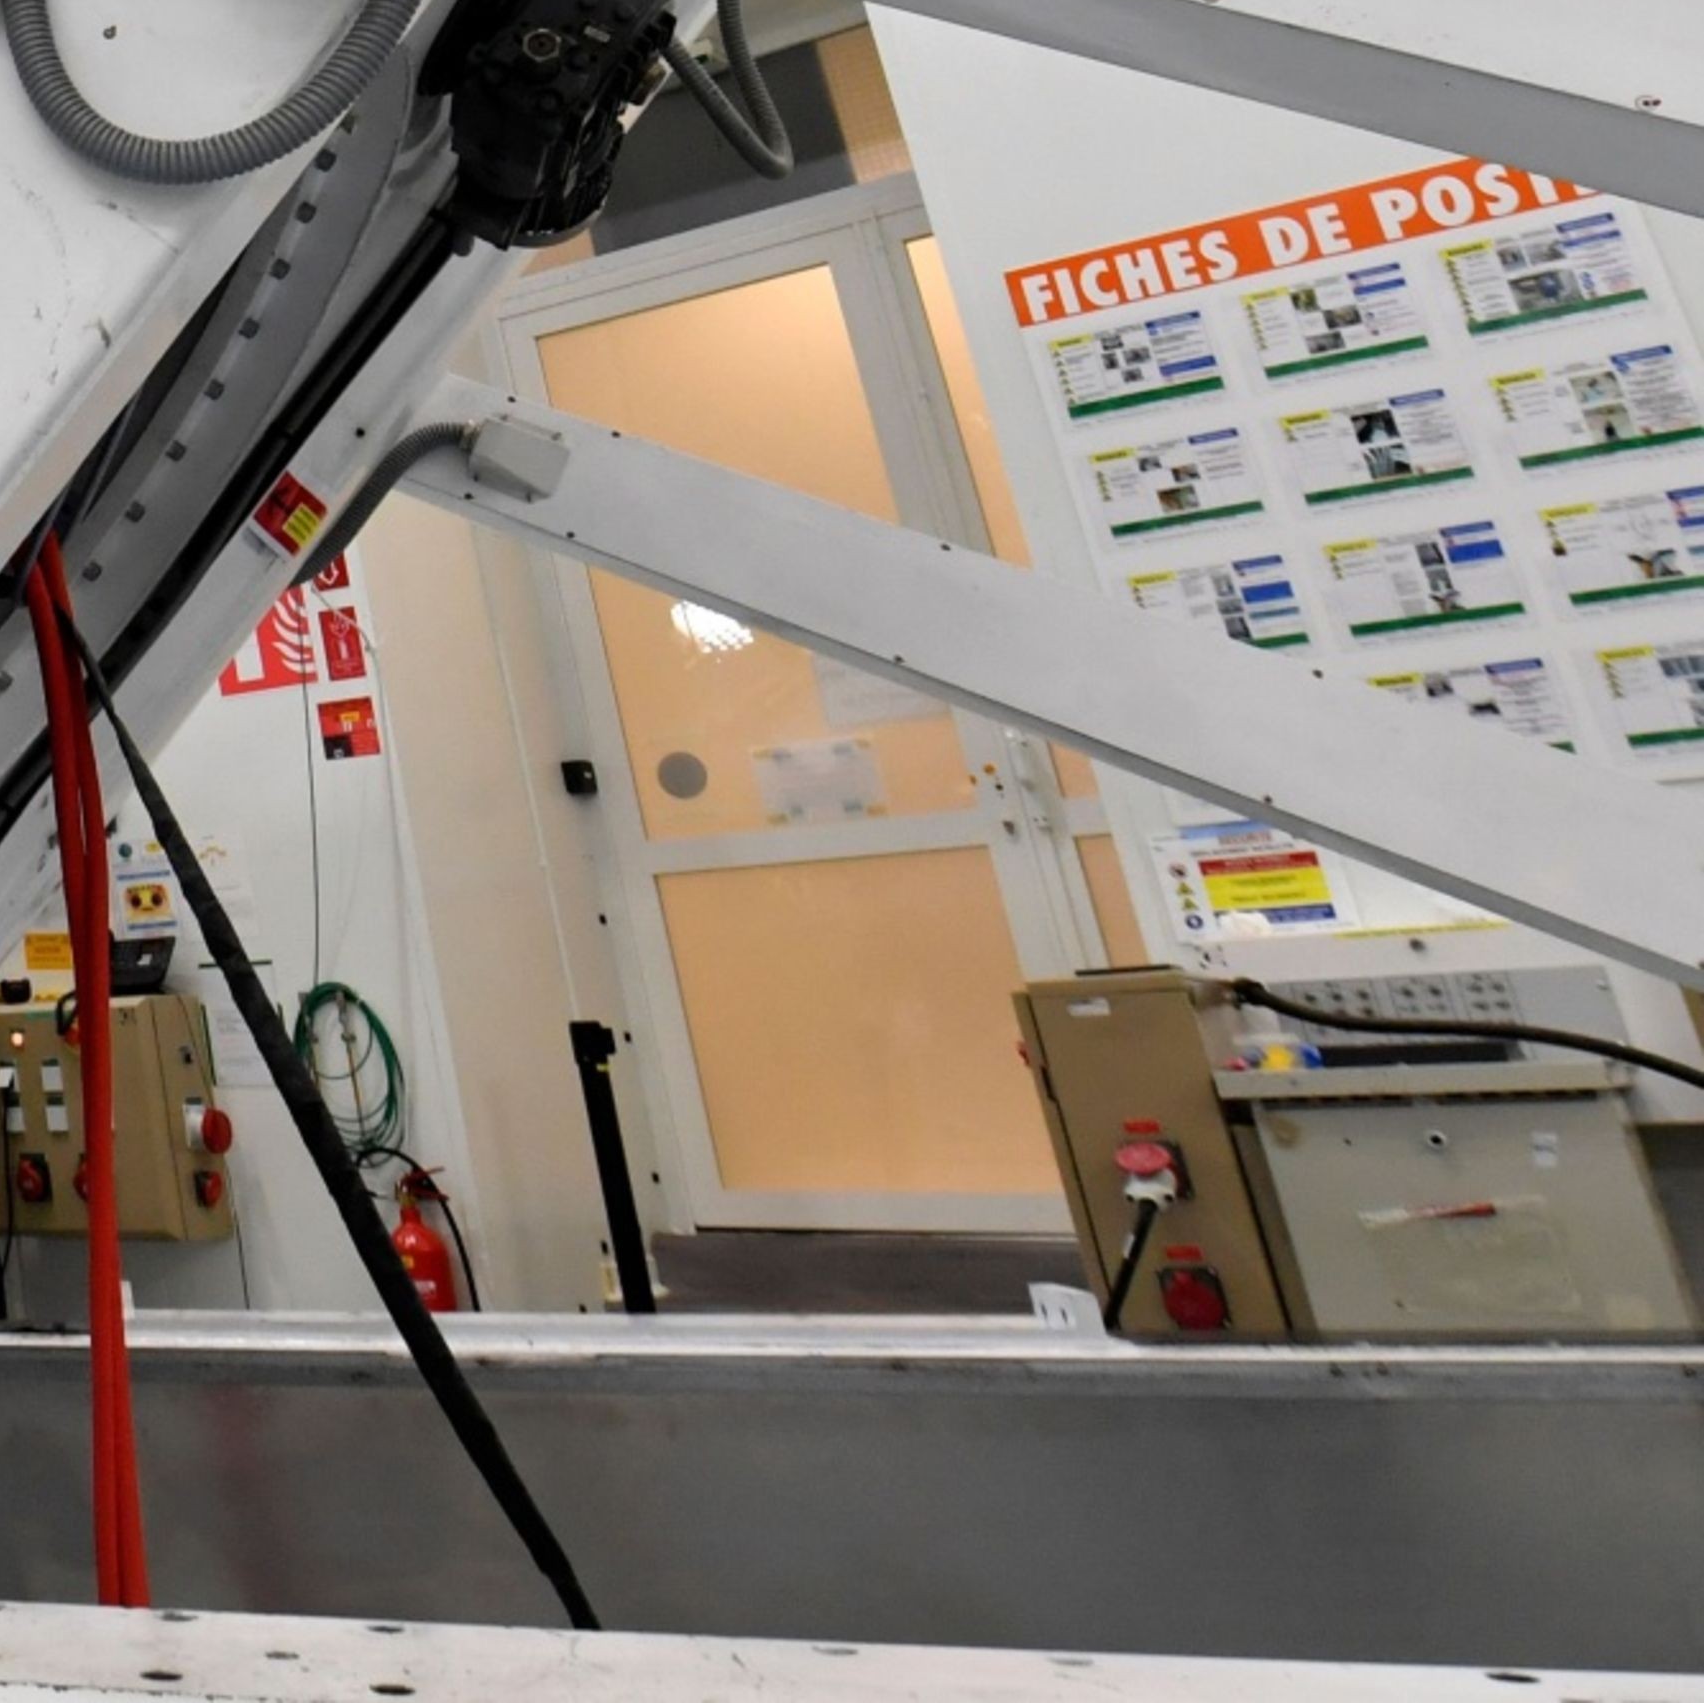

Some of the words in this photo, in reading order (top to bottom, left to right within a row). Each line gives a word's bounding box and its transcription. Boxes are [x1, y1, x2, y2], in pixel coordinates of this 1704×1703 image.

[1020, 230, 1238, 324] FICHES
[1258, 204, 1357, 267] DE
[1369, 162, 1599, 242] POS
